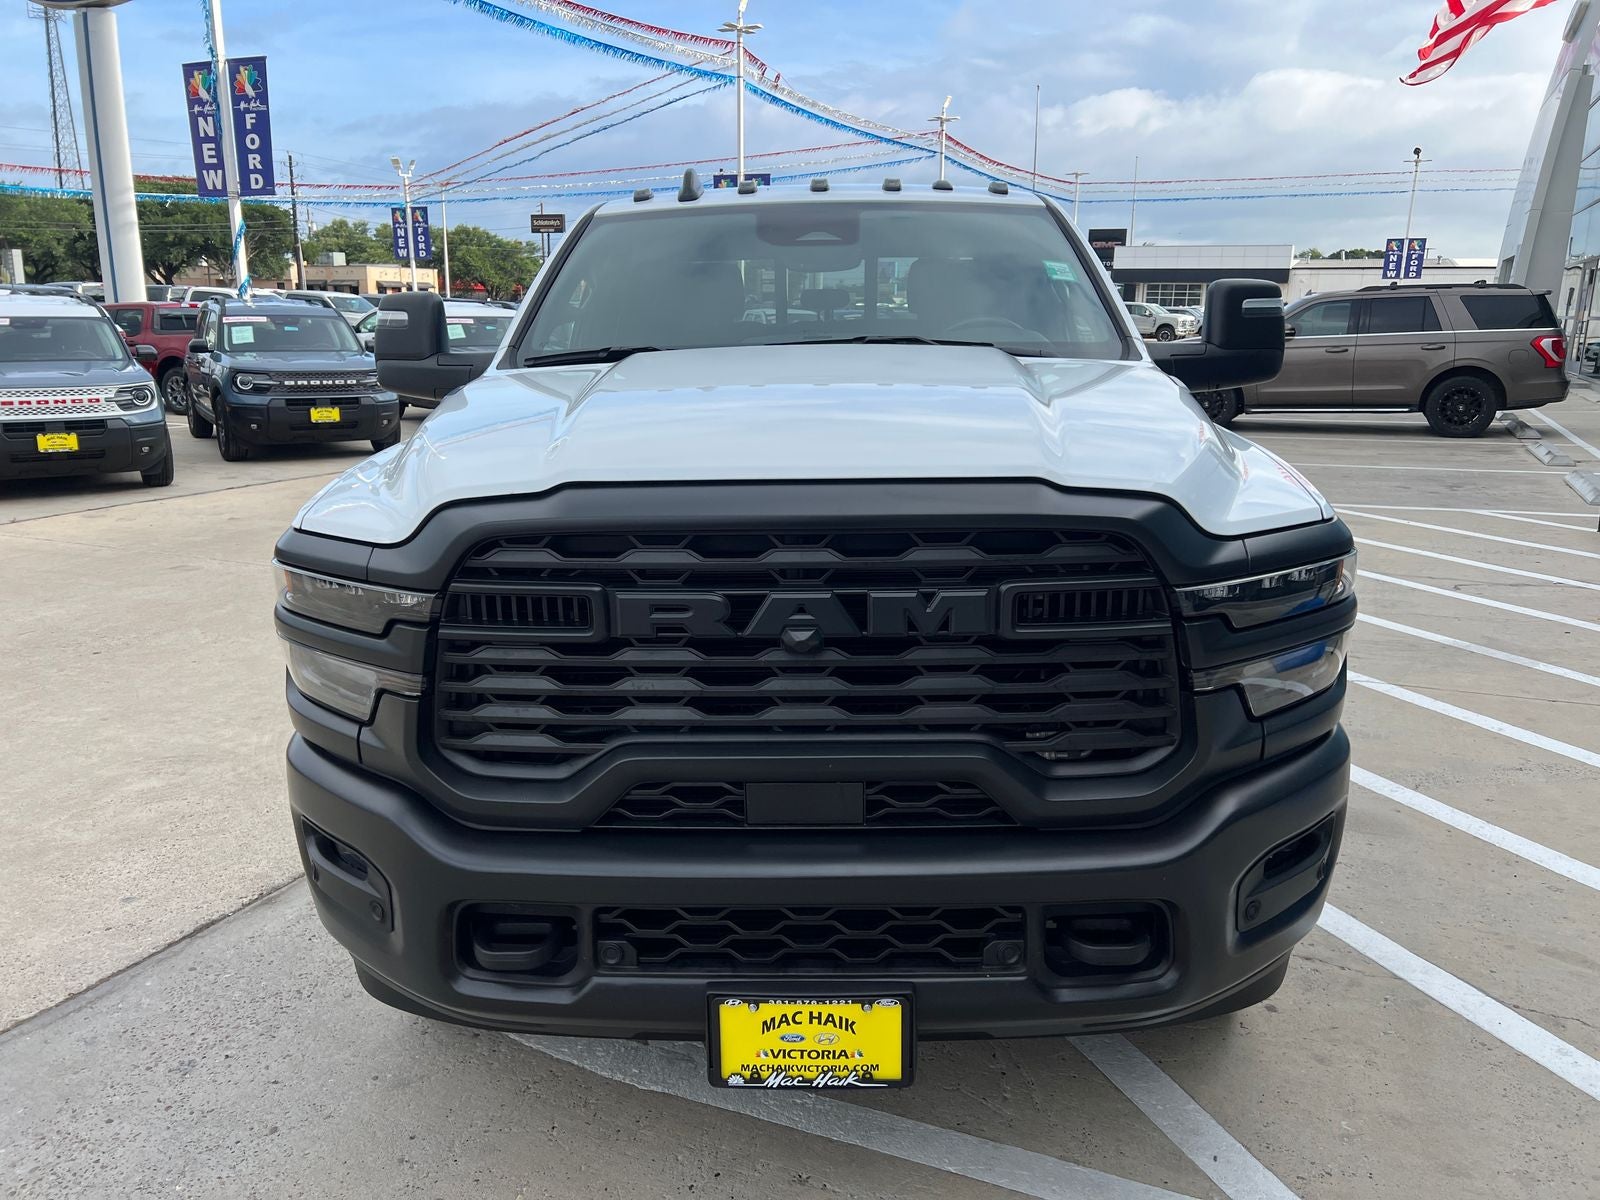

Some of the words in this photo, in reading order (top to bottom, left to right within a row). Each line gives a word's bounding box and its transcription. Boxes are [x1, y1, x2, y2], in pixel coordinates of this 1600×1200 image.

[197, 116, 223, 190] NEW
[245, 113, 264, 189] FORD
[397, 228, 407, 257] NEW
[417, 227, 427, 257] FORD
[1386, 254, 1398, 278] NEW
[1408, 253, 1419, 278] FORD
[0, 398, 101, 406] BRONCO
[614, 590, 994, 638] RAM
[761, 1011, 803, 1035] MAC
[808, 1011, 857, 1035] HAIK
[781, 1033, 804, 1042] Ford
[769, 1048, 850, 1060] VICTORIA
[759, 1070, 810, 1088] Mac
[811, 1070, 872, 1088] Haik
